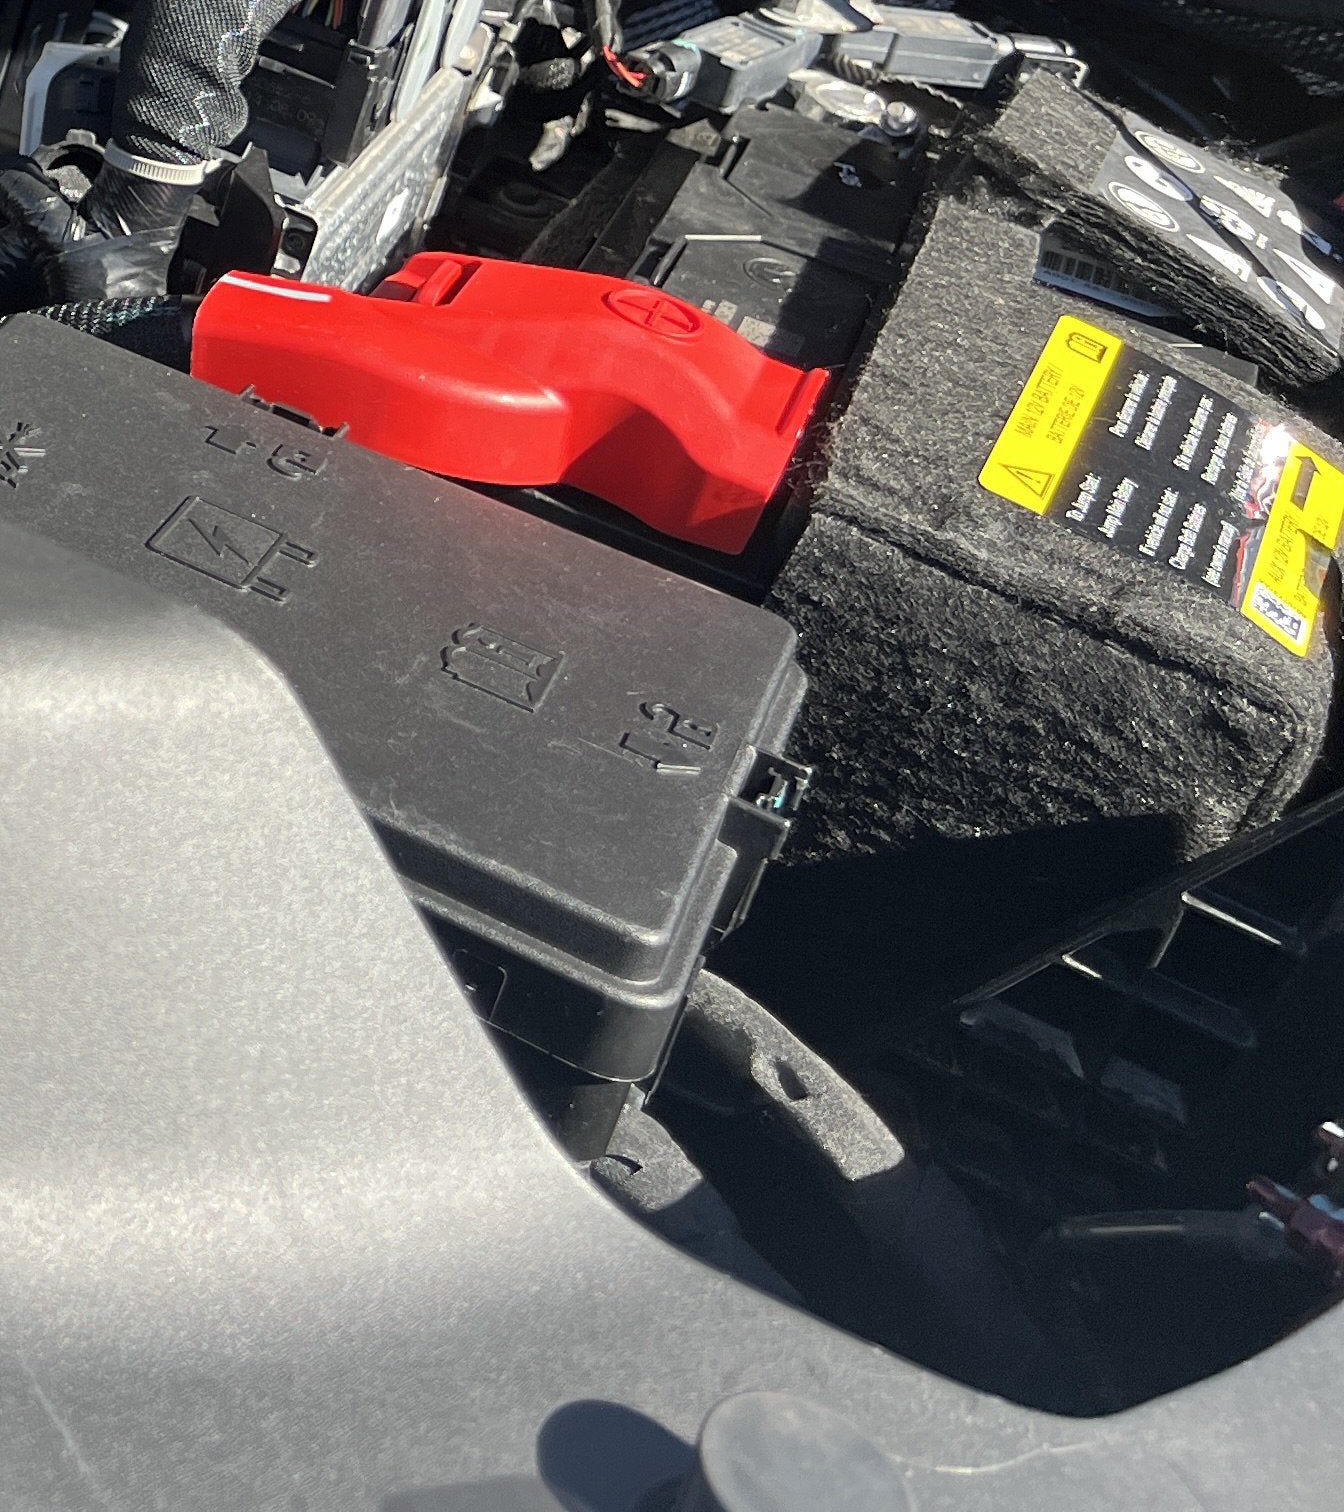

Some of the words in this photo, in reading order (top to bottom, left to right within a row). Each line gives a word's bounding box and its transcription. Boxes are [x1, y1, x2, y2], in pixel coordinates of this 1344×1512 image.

[1032, 367, 1061, 403] BATTERY
[1026, 400, 1044, 416] 12V
[1015, 414, 1038, 438] MAIN
[1046, 407, 1075, 444] BATTERIE
[1113, 477, 1139, 503] Battery
[1071, 491, 1097, 515] Jump
[1106, 499, 1126, 519] Main
[1158, 503, 1173, 518] not
[1066, 510, 1085, 521] To
[1098, 515, 1123, 538] Jump
[1152, 512, 1168, 529] will
[1183, 503, 1206, 533] Batteries
[1143, 524, 1165, 550] vehicle
[1178, 528, 1197, 547] Both
[1169, 543, 1195, 569] Charge
